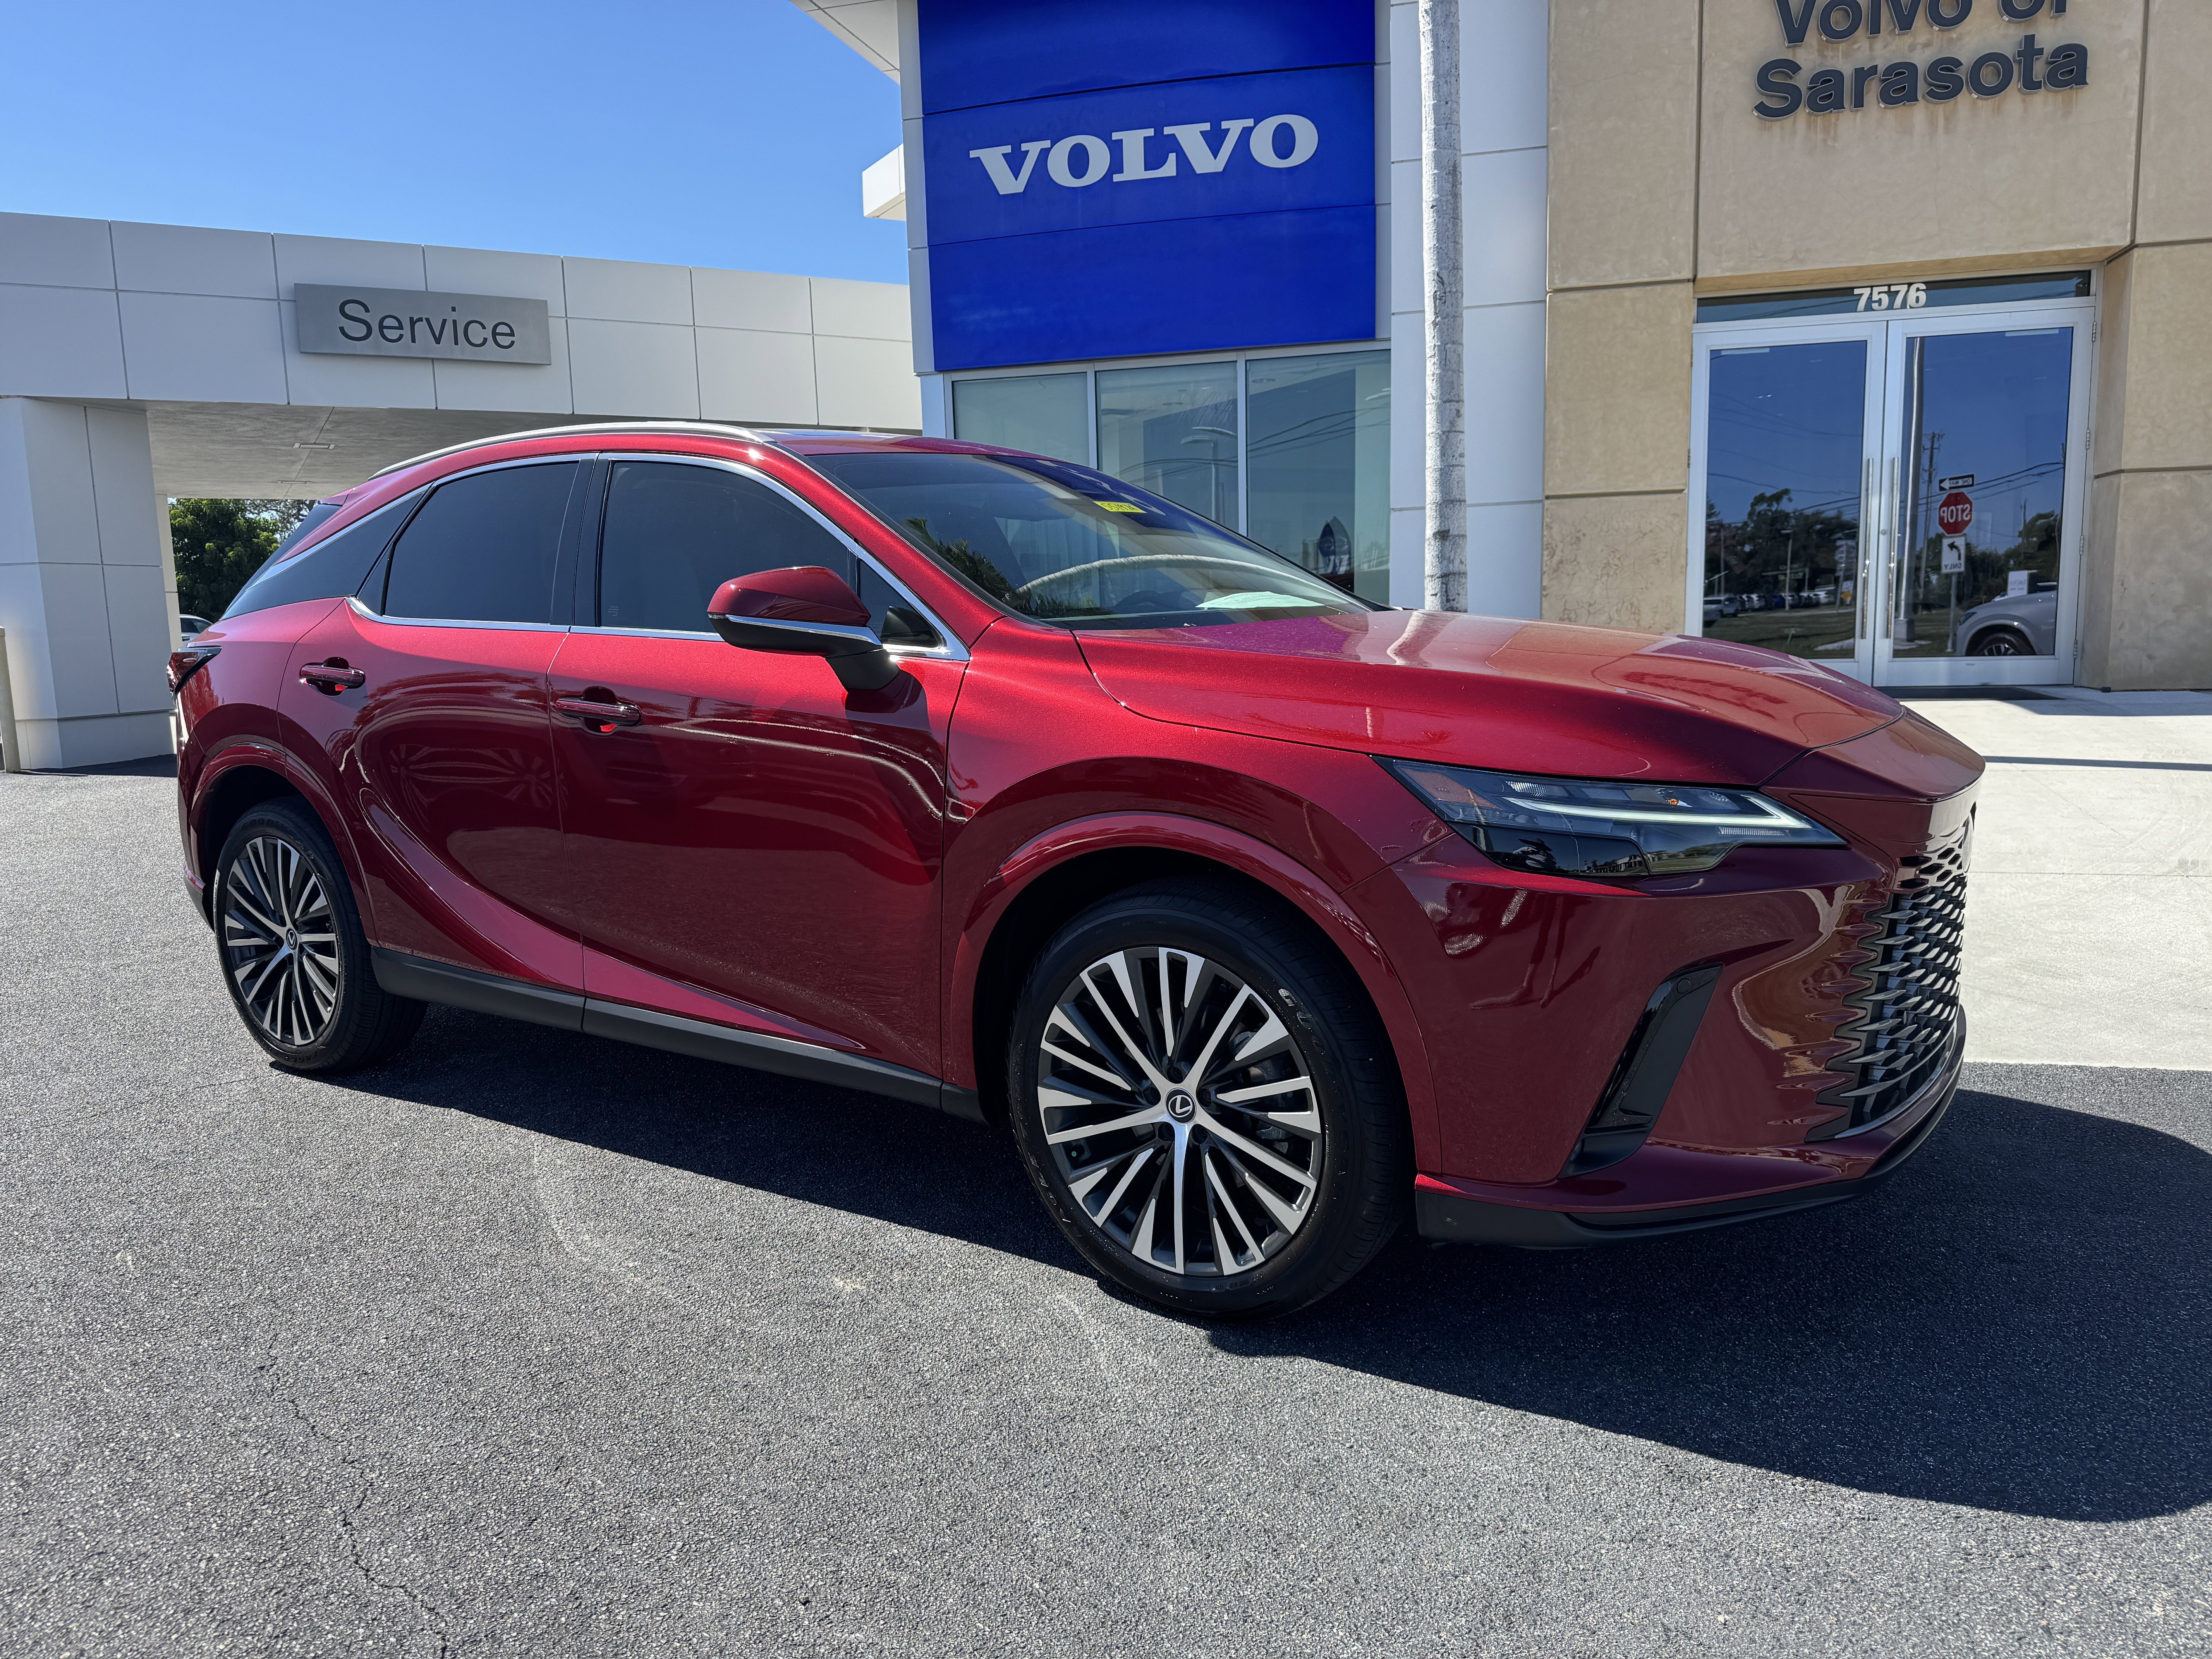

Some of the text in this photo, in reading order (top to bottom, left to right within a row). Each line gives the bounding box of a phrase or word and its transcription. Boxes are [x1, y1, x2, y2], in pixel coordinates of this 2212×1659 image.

[1776, 0, 1973, 48] Volvo
[1752, 34, 2088, 121] Sarasota
[969, 114, 1318, 195] VOLVO
[1854, 283, 1926, 312] 7576
[338, 299, 515, 349] Service
